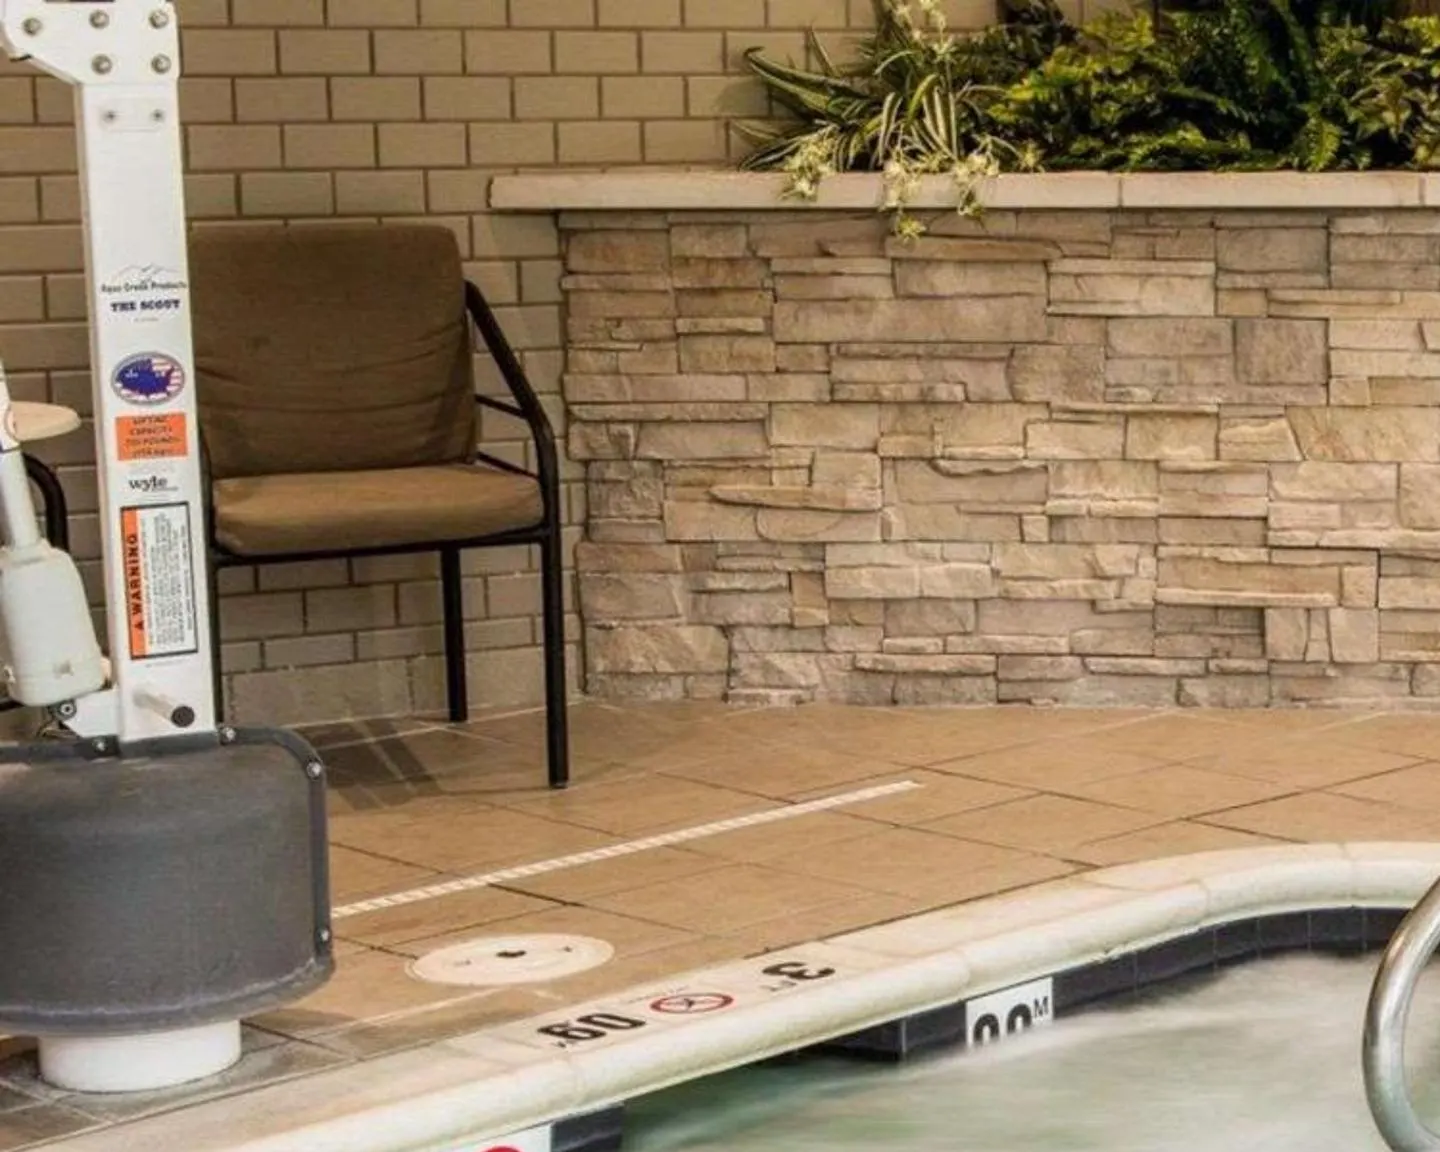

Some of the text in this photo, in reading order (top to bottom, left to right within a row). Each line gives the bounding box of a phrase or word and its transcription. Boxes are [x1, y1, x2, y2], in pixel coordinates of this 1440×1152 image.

[110, 298, 181, 312] THE SCOUT
[126, 534, 143, 616] WARNING
